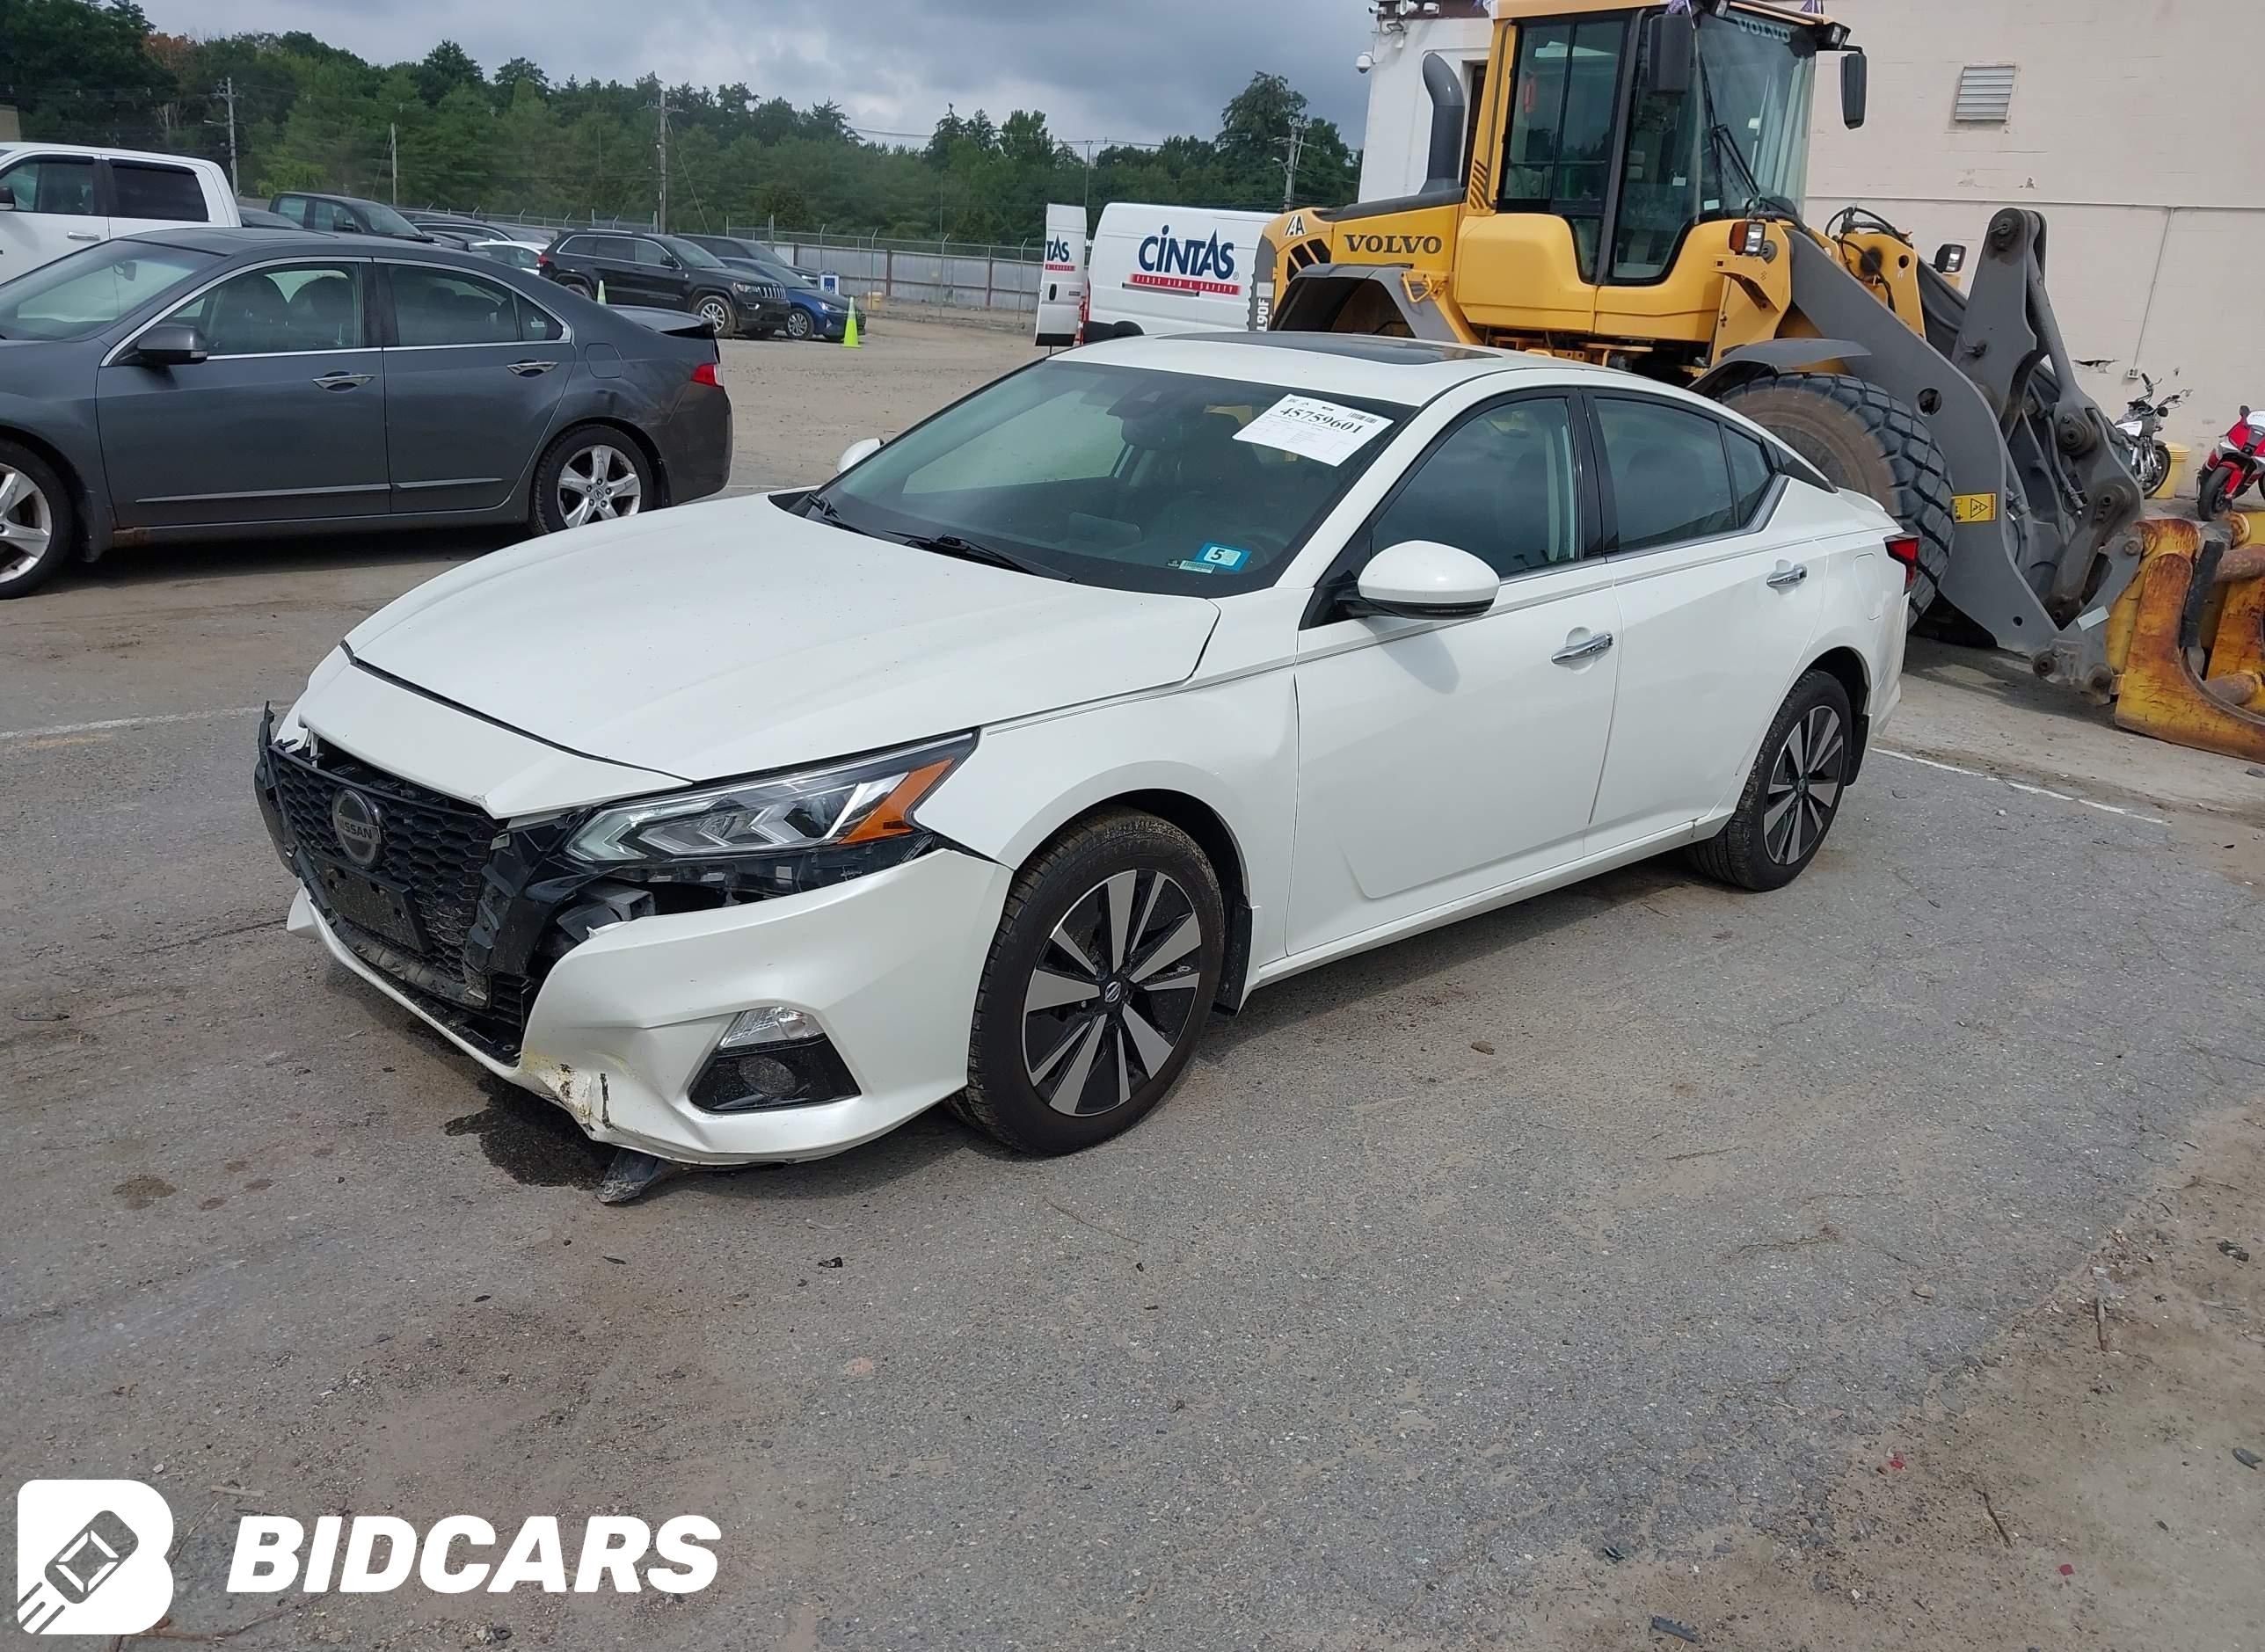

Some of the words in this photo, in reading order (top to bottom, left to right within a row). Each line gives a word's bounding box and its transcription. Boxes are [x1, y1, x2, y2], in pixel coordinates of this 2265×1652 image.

[1735, 17, 1791, 43] VOLVO
[1046, 233, 1070, 263] TAS
[1344, 234, 1443, 255] VOLVO
[1136, 275, 1162, 286] FIRST
[1167, 279, 1183, 287] AID
[1199, 281, 1234, 294] SAFETY
[1256, 297, 1270, 331] L90F
[1280, 407, 1365, 433] 45759601
[1211, 549, 1226, 560] 5
